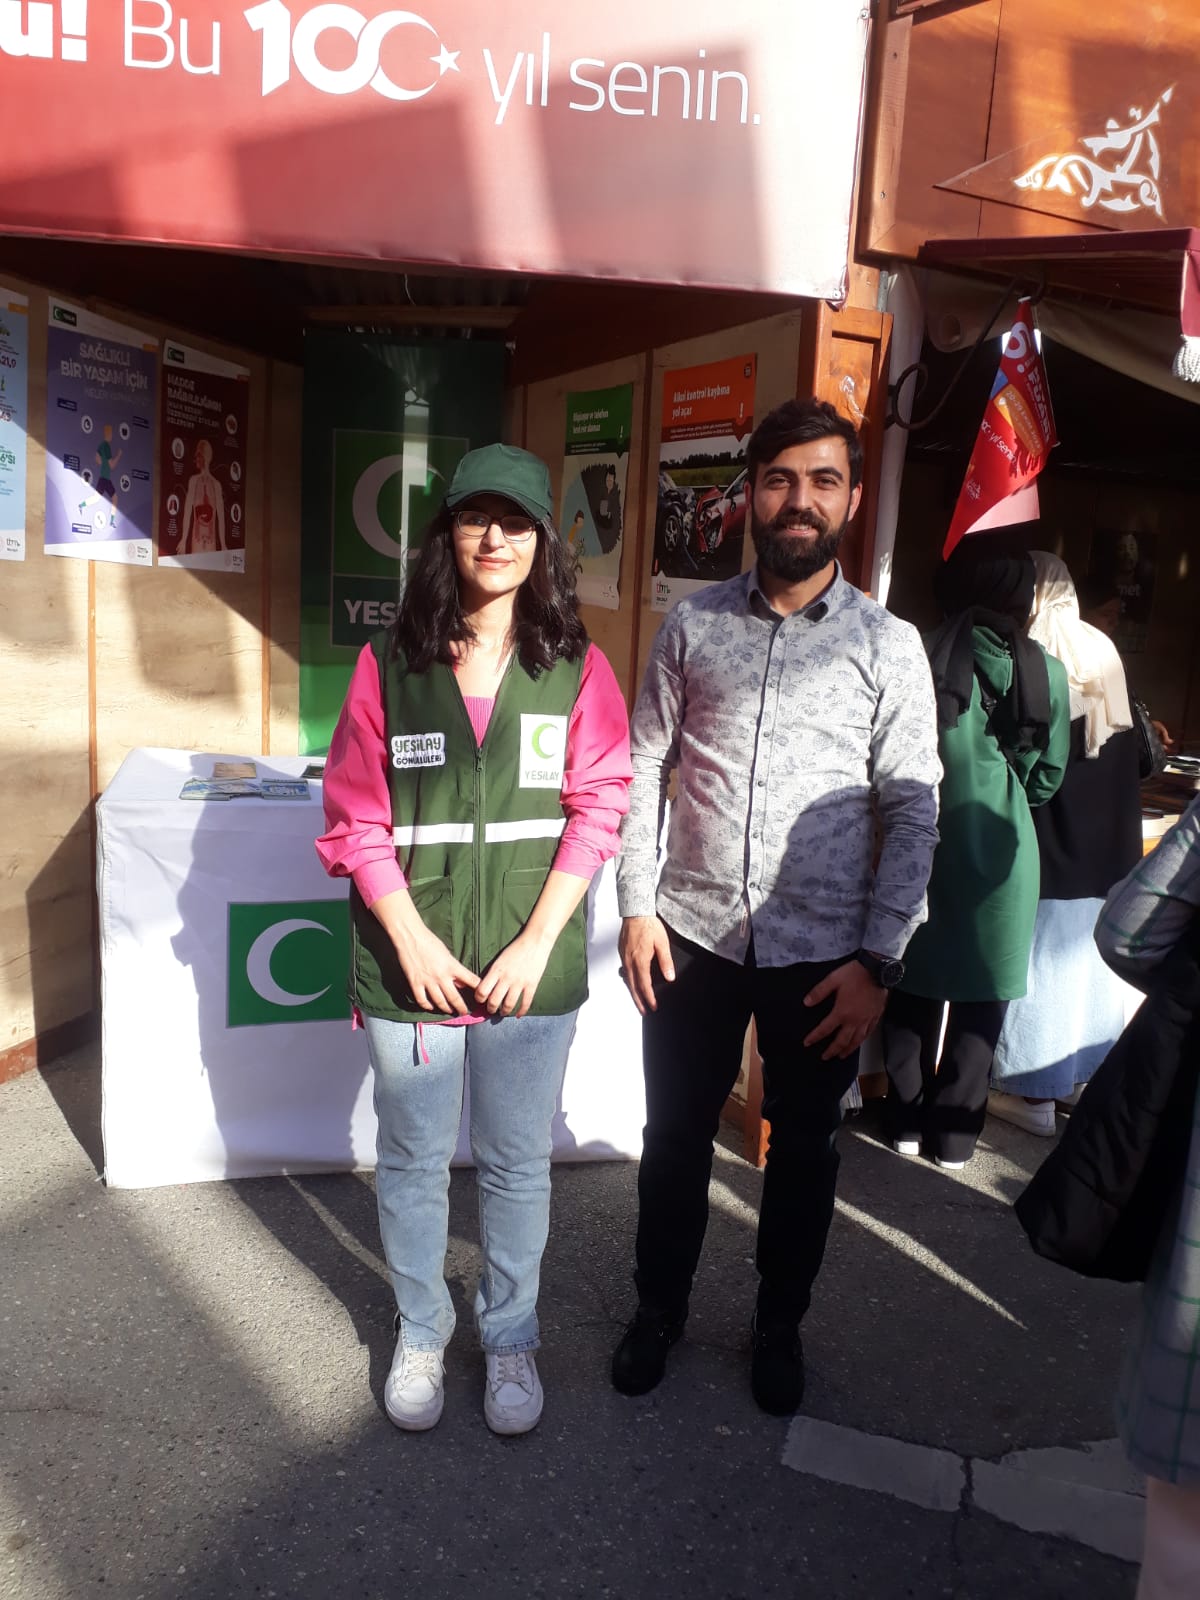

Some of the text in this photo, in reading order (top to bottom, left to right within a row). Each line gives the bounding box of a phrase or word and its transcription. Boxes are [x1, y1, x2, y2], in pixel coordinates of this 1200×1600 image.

[124, 0, 221, 75] Bu
[483, 31, 551, 125] yıl
[569, 49, 761, 125] senin.
[79, 342, 131, 367] SAĞLIKLI
[61, 358, 81, 378] BİR
[83, 364, 124, 387] YAŞAM
[687, 386, 707, 400] kontrol
